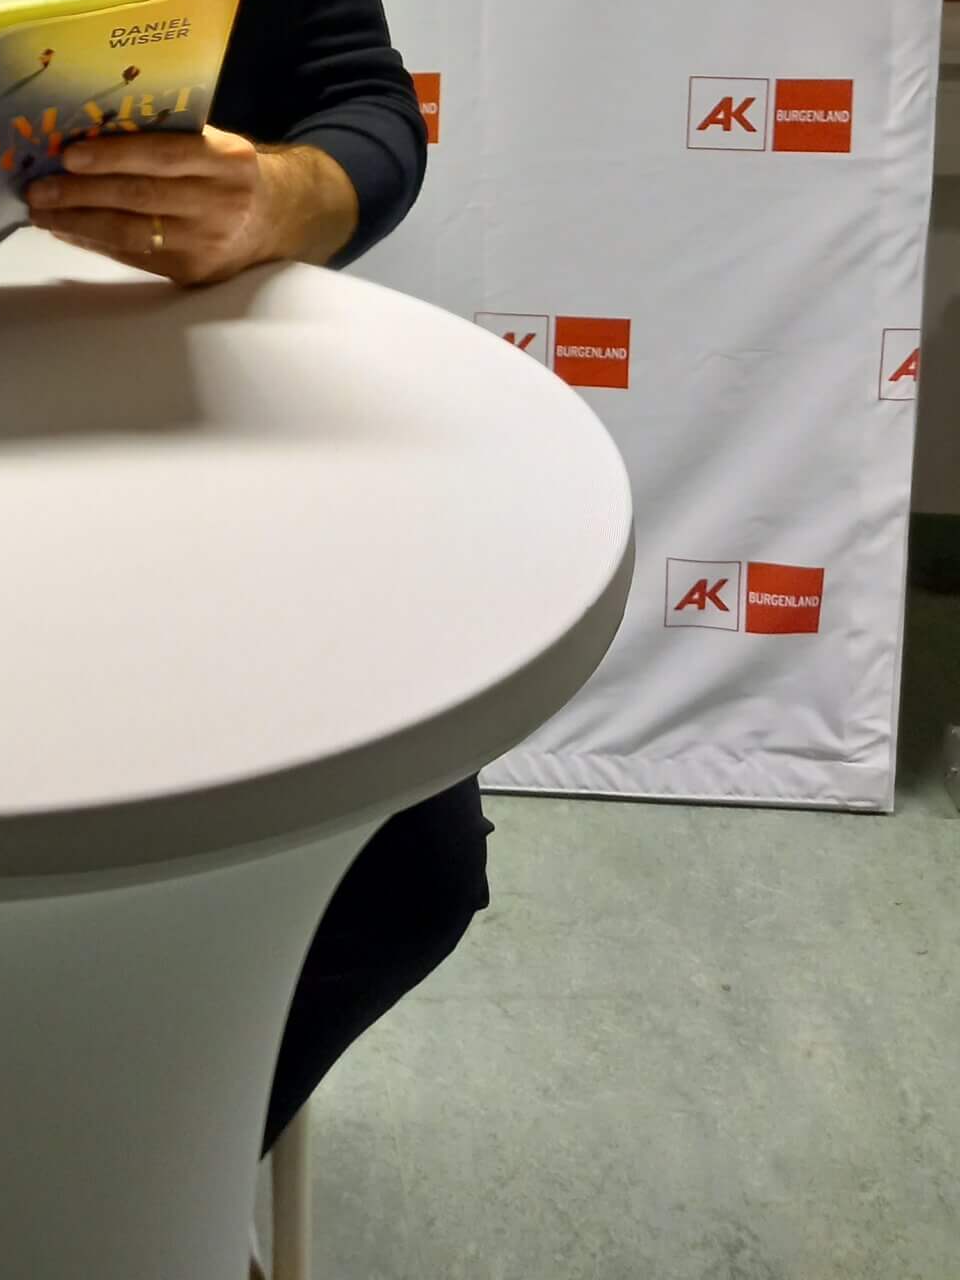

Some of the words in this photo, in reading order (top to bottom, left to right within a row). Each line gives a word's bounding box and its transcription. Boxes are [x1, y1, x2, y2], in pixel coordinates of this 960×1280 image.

[111, 17, 191, 38] DANIEL
[109, 28, 190, 49] WISSER
[696, 96, 757, 132] AK
[776, 109, 850, 123] BURGENLAND
[556, 345, 627, 360] BURGENLAND
[674, 578, 730, 612] AK
[748, 591, 820, 608] BURGENLAND
